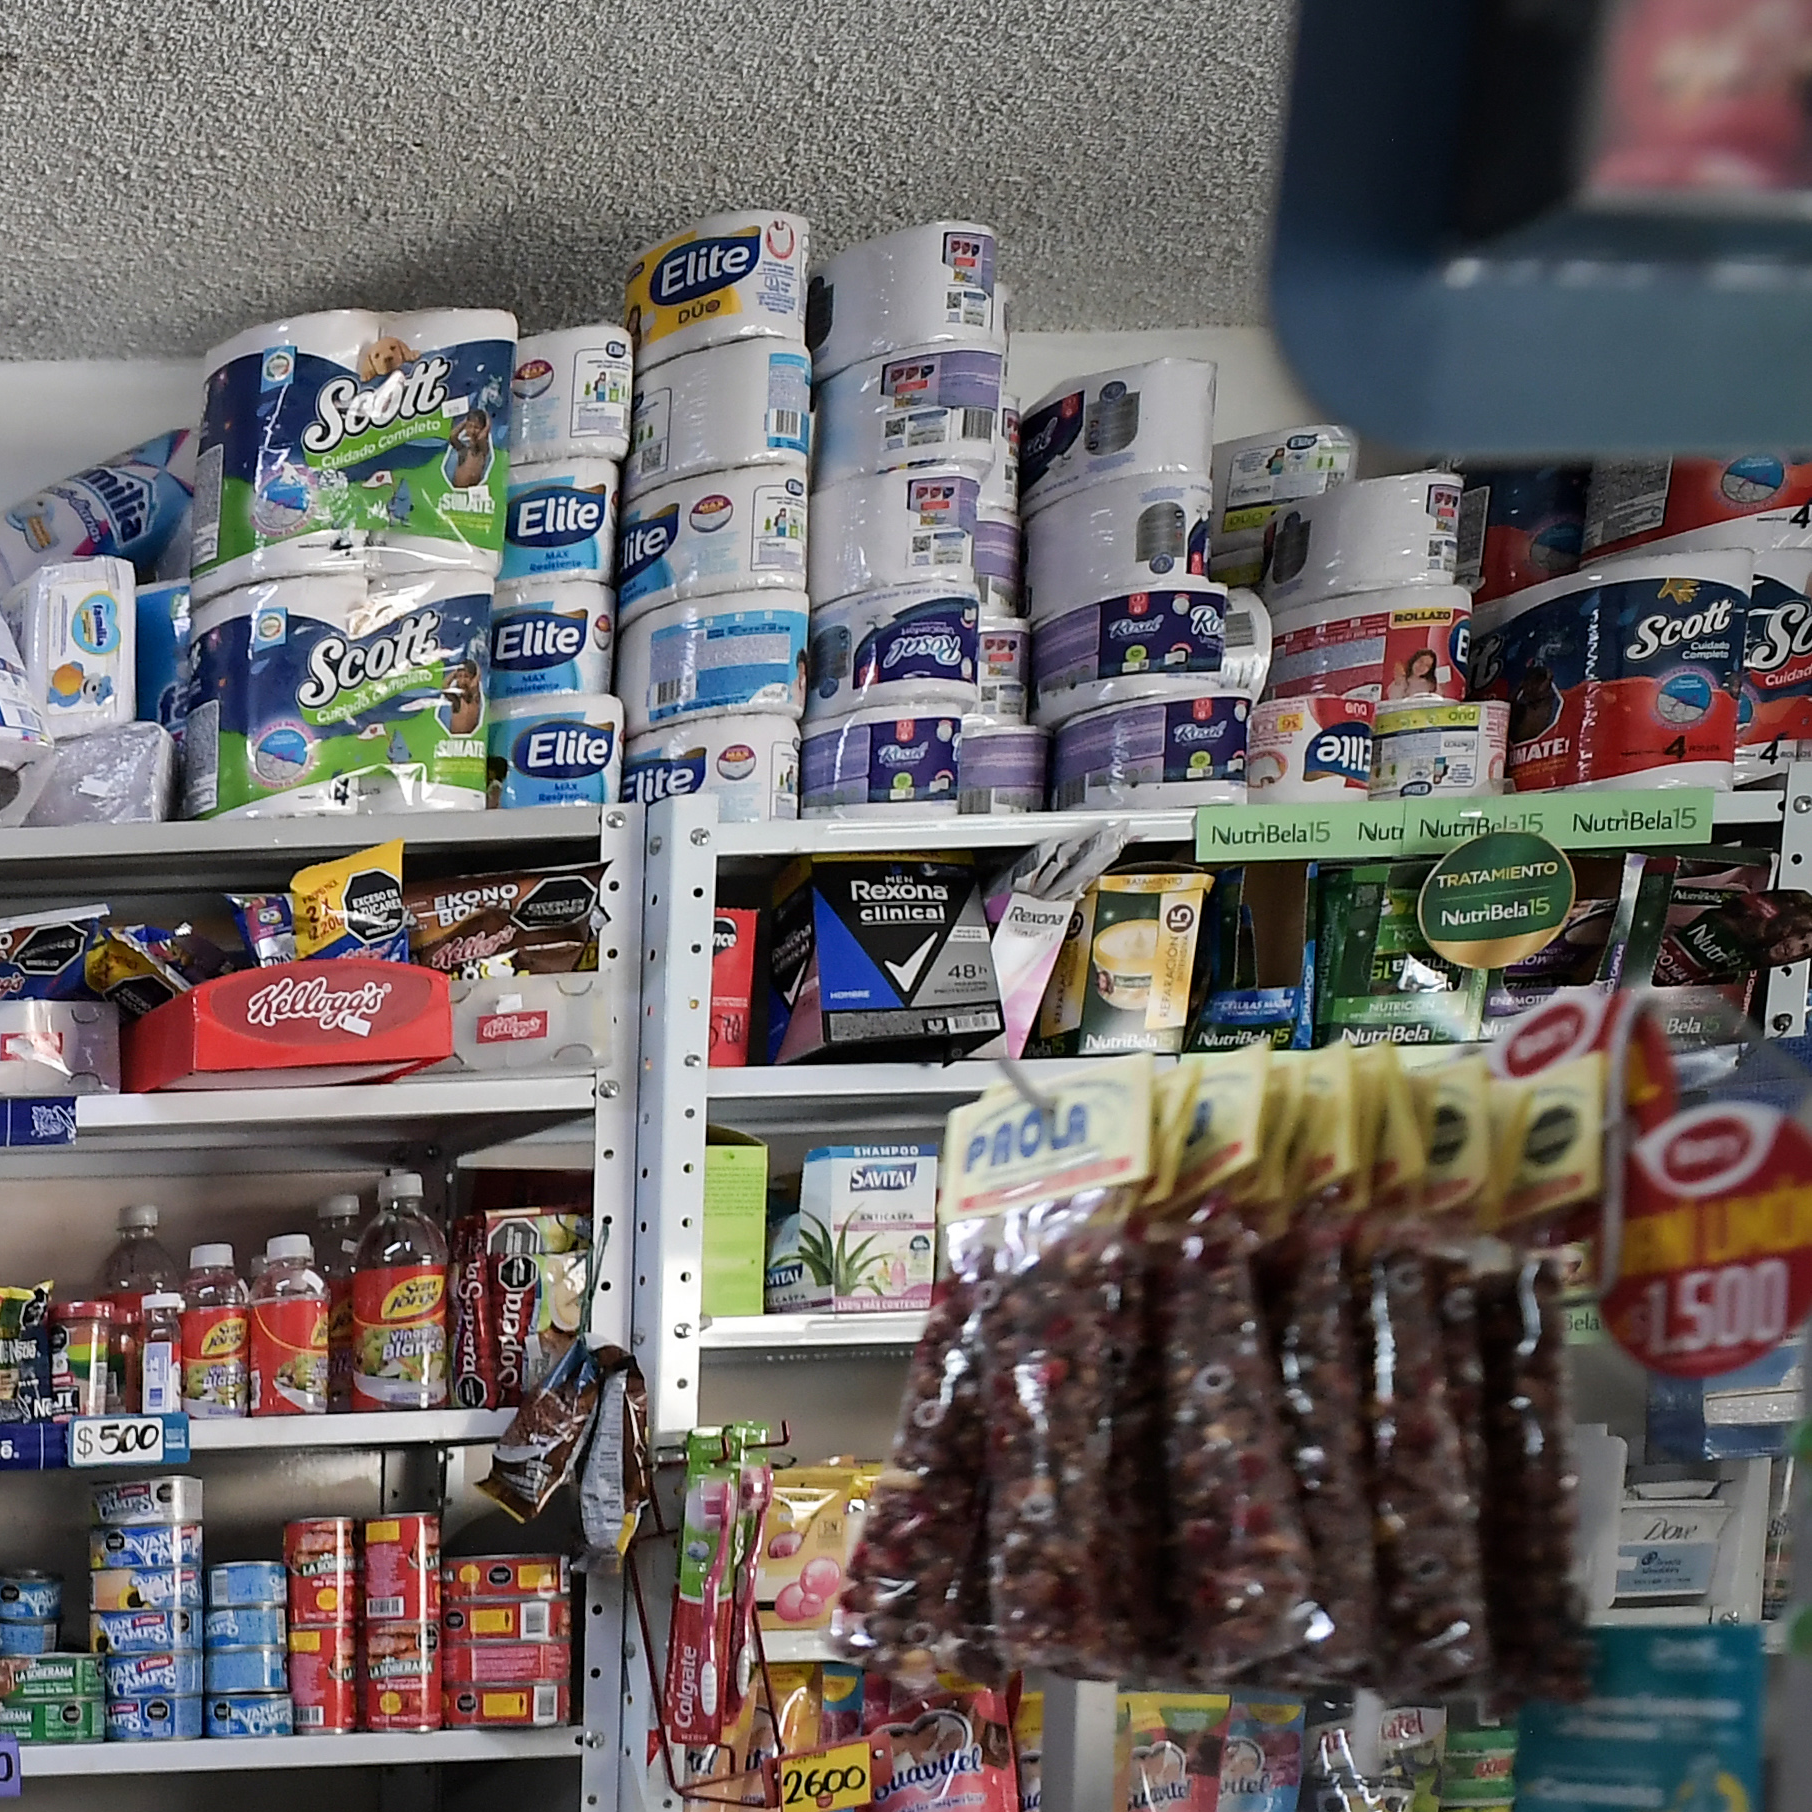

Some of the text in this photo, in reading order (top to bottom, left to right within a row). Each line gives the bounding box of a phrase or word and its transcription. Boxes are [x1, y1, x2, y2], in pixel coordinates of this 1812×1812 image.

[660, 243, 750, 297] Elite
[304, 356, 450, 453] Scott
[322, 420, 441, 468] Cuidado Completo
[518, 499, 600, 536] Elite
[1394, 609, 1450, 624] ROLLAZO
[496, 622, 579, 660] Elite
[1626, 600, 1732, 661] Scott
[1682, 650, 1729, 660] Completo
[1690, 641, 1730, 651] Cuidado
[299, 610, 439, 709] Scott
[528, 732, 608, 768] Elite
[1665, 735, 1687, 759] 4
[1572, 807, 1697, 833] NutriBela15
[1212, 821, 1331, 846] NutriBela15
[1436, 861, 1558, 888] TRATAMIENTO
[352, 890, 399, 908] EXCESO EN
[434, 884, 519, 907] EKONO
[851, 879, 947, 901] Rexona
[861, 904, 945, 921] clinical
[1008, 905, 1066, 926] Rexona
[1440, 897, 1550, 927] NutriBela15
[247, 978, 384, 1028] Kellogg's
[854, 1146, 919, 1156] SHAMPOO
[850, 1168, 916, 1190] SAVITAL
[382, 1338, 443, 1360] Blanco
[675, 1645, 696, 1728] Colgate
[782, 1767, 867, 1804] 2600
